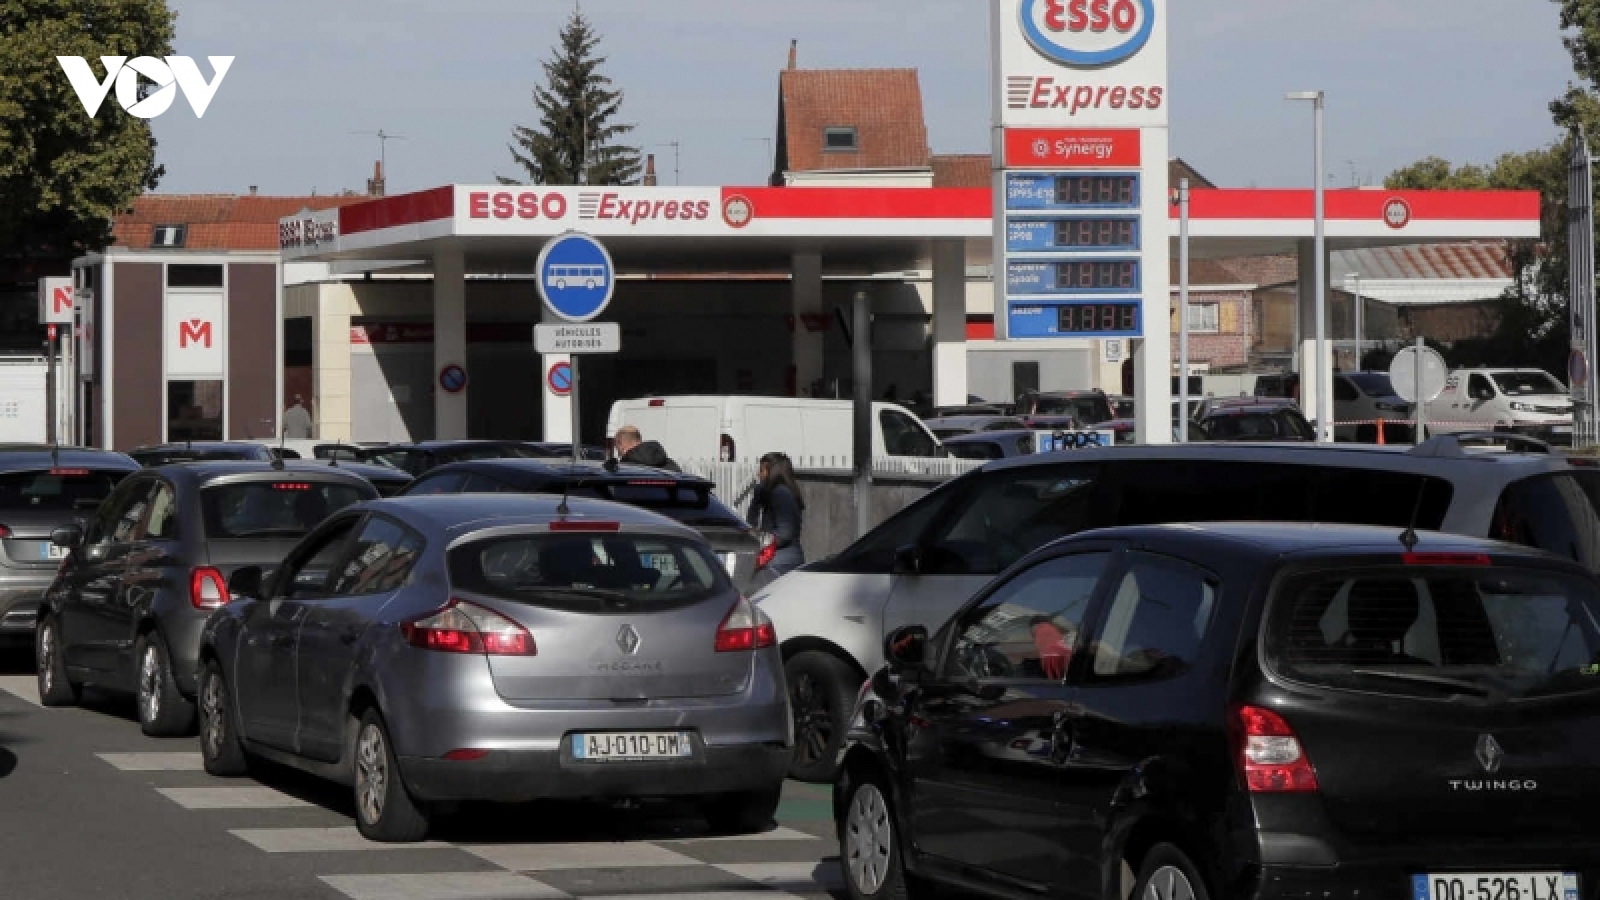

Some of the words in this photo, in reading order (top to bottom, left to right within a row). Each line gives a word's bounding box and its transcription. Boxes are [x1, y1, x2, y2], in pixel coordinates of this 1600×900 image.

[1030, 76, 1164, 117] Express
[1055, 139, 1114, 159] Synergy
[469, 191, 567, 220] ESSO
[597, 193, 710, 225] Express
[1448, 779, 1538, 791] TWINGO
